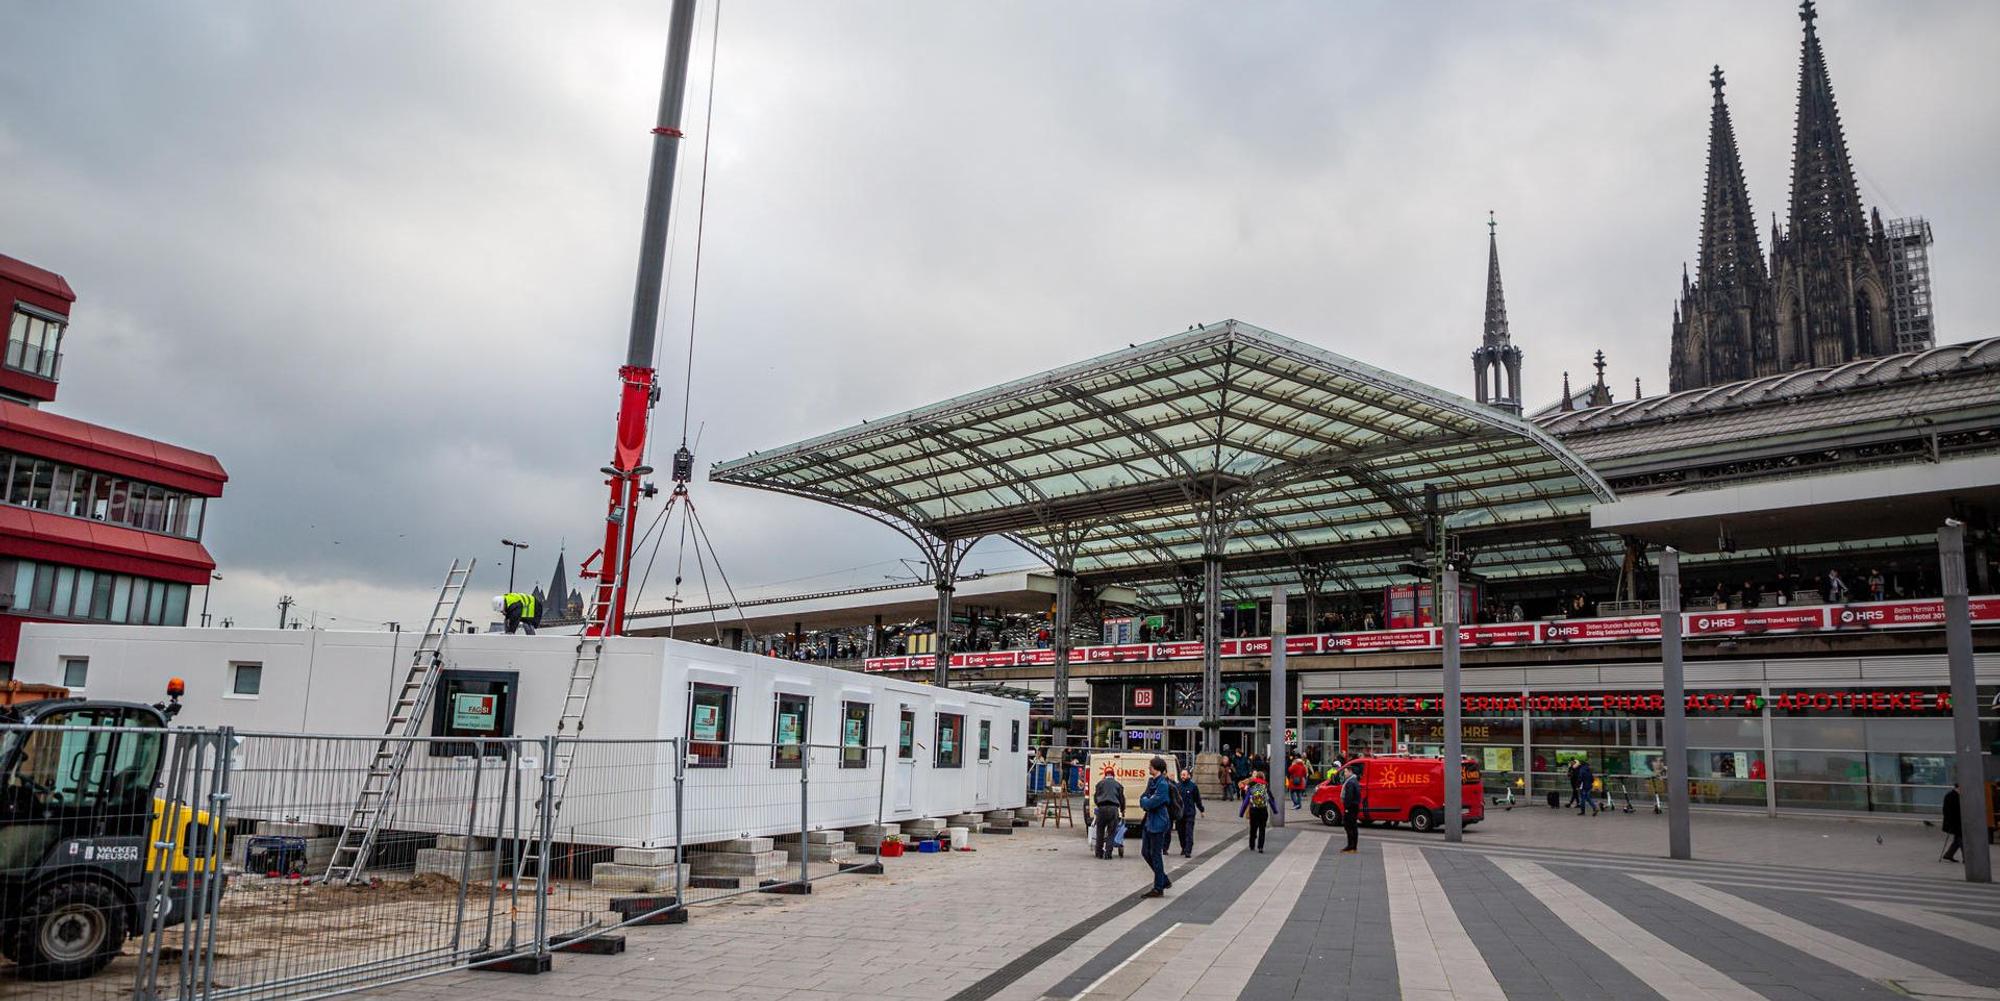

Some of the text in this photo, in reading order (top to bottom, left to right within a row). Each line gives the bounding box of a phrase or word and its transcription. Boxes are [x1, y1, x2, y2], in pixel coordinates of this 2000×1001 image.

[1857, 611, 1884, 622] HRS
[1711, 618, 1735, 628] HRS
[1558, 627, 1579, 636] HRS
[1253, 643, 1267, 651] HRS
[1335, 638, 1352, 646] HRS
[1162, 647, 1175, 655] HRS
[1136, 690, 1150, 704] DB
[1226, 689, 1237, 705] S
[1320, 692, 1926, 712] APOTHEKE IERNATIONAL PHARACY APOTHEKE
